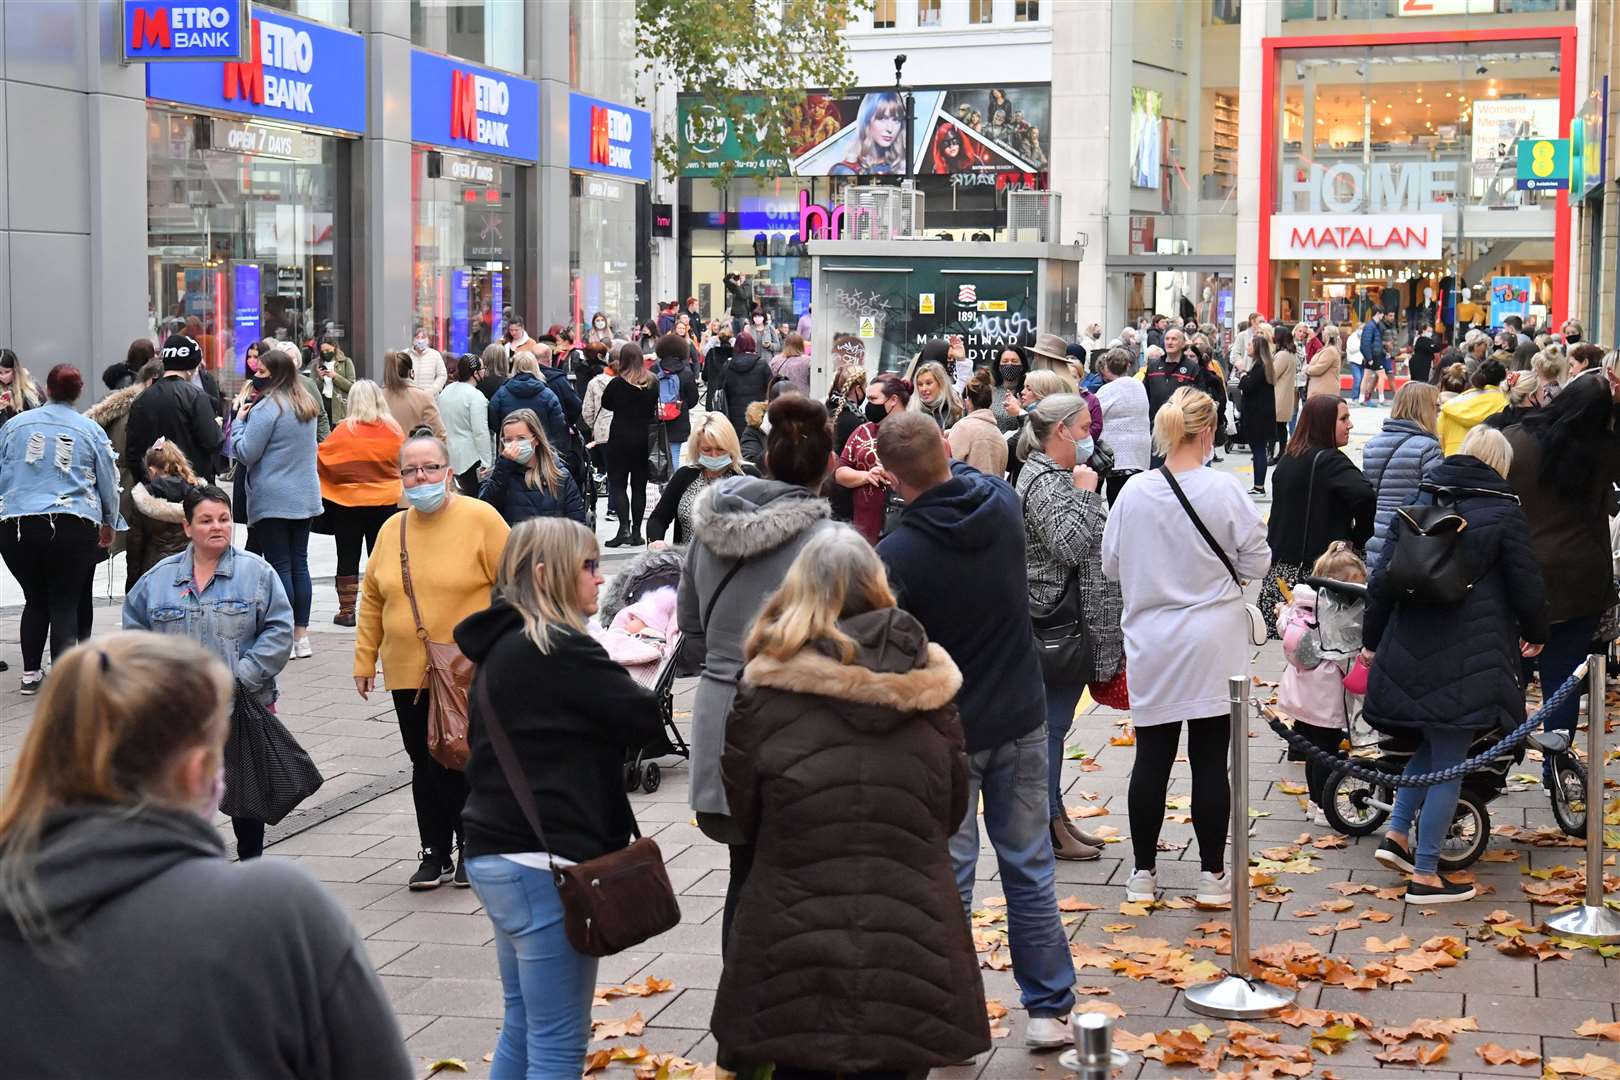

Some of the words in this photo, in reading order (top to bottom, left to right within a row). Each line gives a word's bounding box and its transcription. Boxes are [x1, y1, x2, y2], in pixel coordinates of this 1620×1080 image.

[132, 7, 230, 49] METRO
[174, 31, 230, 48] BANK
[223, 18, 313, 105] METRO
[263, 76, 314, 114] BANK
[451, 70, 509, 143] METRO
[228, 129, 256, 150] OPEN
[258, 129, 267, 151] 7
[268, 135, 292, 154] DAYS
[478, 119, 510, 149] BANK
[591, 105, 632, 165] METRO
[608, 146, 632, 170] BANK
[1282, 162, 1459, 215] HOME
[1290, 226, 1428, 250] MATALAN
[958, 311, 977, 322] 1891
[916, 333, 1018, 346] MHNAD
